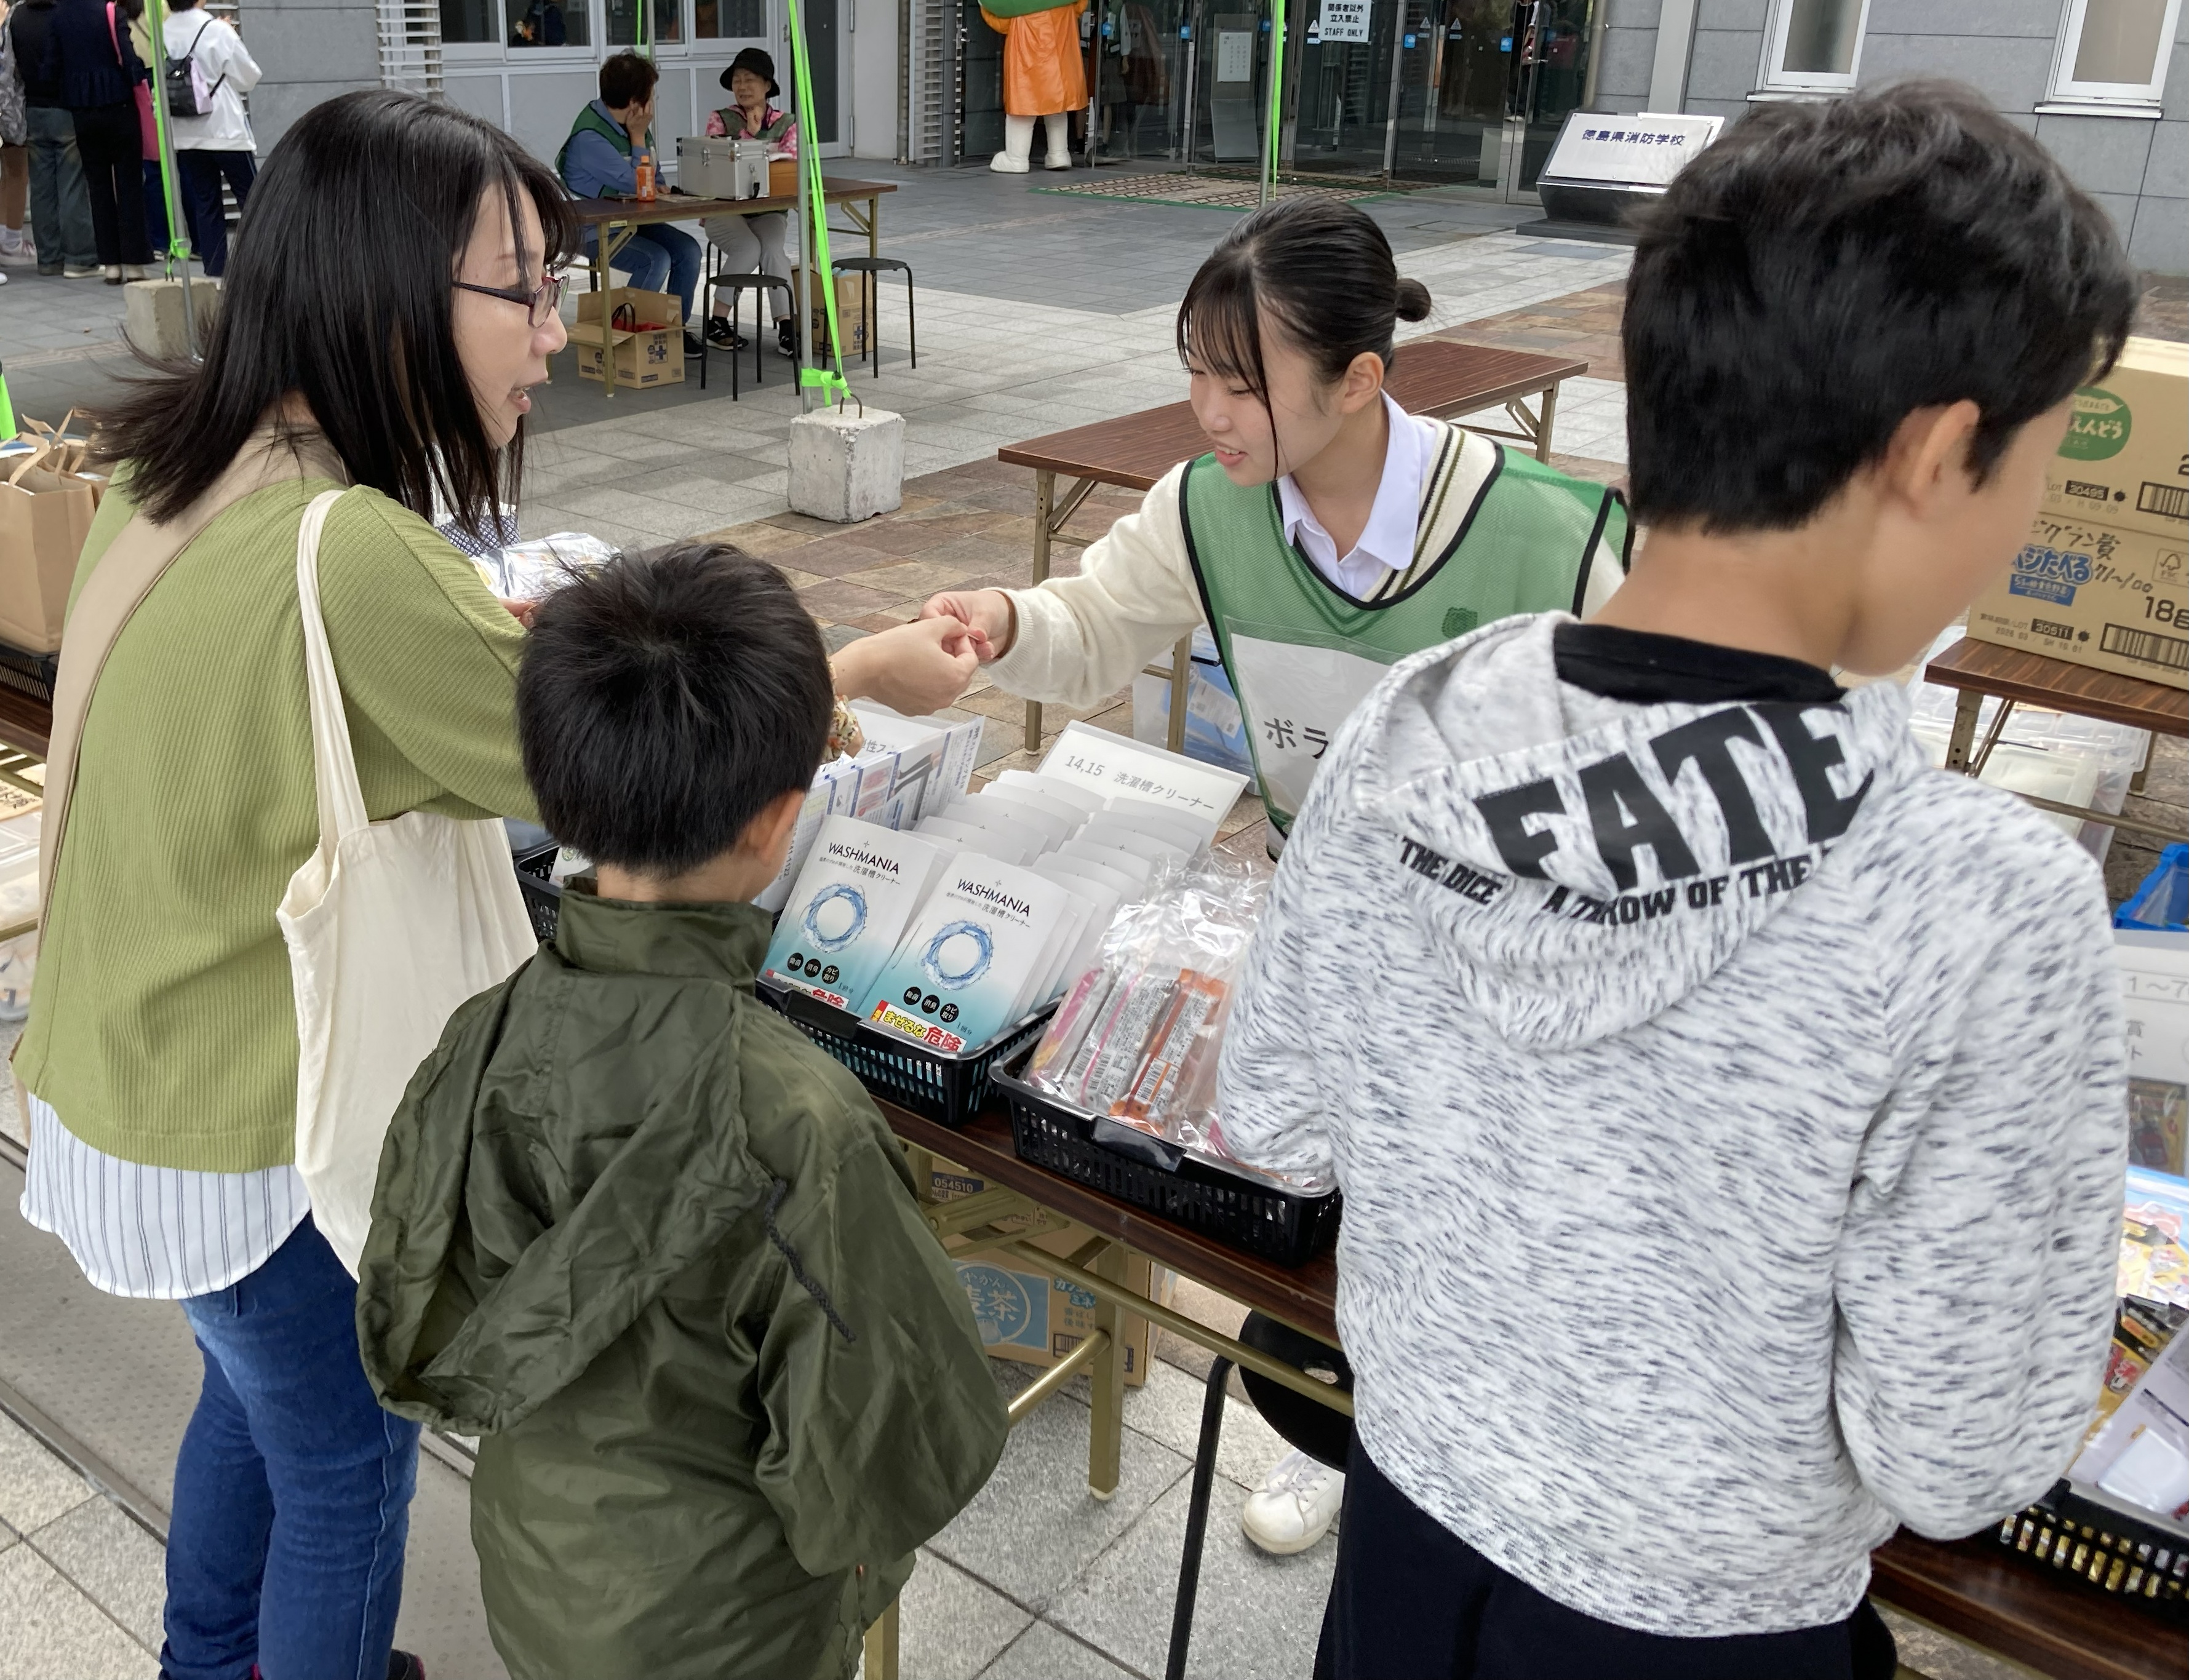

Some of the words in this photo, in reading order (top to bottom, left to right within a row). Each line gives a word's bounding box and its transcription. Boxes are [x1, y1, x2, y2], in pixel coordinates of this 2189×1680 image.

[1328, 4, 1364, 12] 関係者以外
[1330, 14, 1359, 23] 立入禁止
[1325, 28, 1344, 36] STAFF
[1582, 129, 1686, 146] 徳島県消防学校
[2035, 621, 2070, 638] 30511
[1064, 755, 1105, 776] 14,15
[1114, 771, 1214, 810] 洗濯槽クリーナー
[1473, 703, 1874, 894] FATE
[829, 842, 899, 875] WASHMANIA
[1398, 835, 1447, 882] THE
[1445, 864, 1504, 907] DICE
[1542, 885, 1564, 913] A
[1688, 875, 1733, 910] OF
[1740, 856, 1812, 899] THE
[957, 878, 1030, 917] WASHMANIA
[789, 957, 802, 967] 除菌
[806, 963, 819, 973] 消臭
[826, 966, 839, 976] カビ
[823, 973, 835, 982] 取り
[905, 990, 920, 1001] 除菌
[923, 998, 938, 1010] 消臭
[946, 1005, 959, 1014] カビ
[941, 1011, 954, 1021] 取り
[956, 1022, 973, 1036] 1回分
[934, 1177, 973, 1193] 054510
